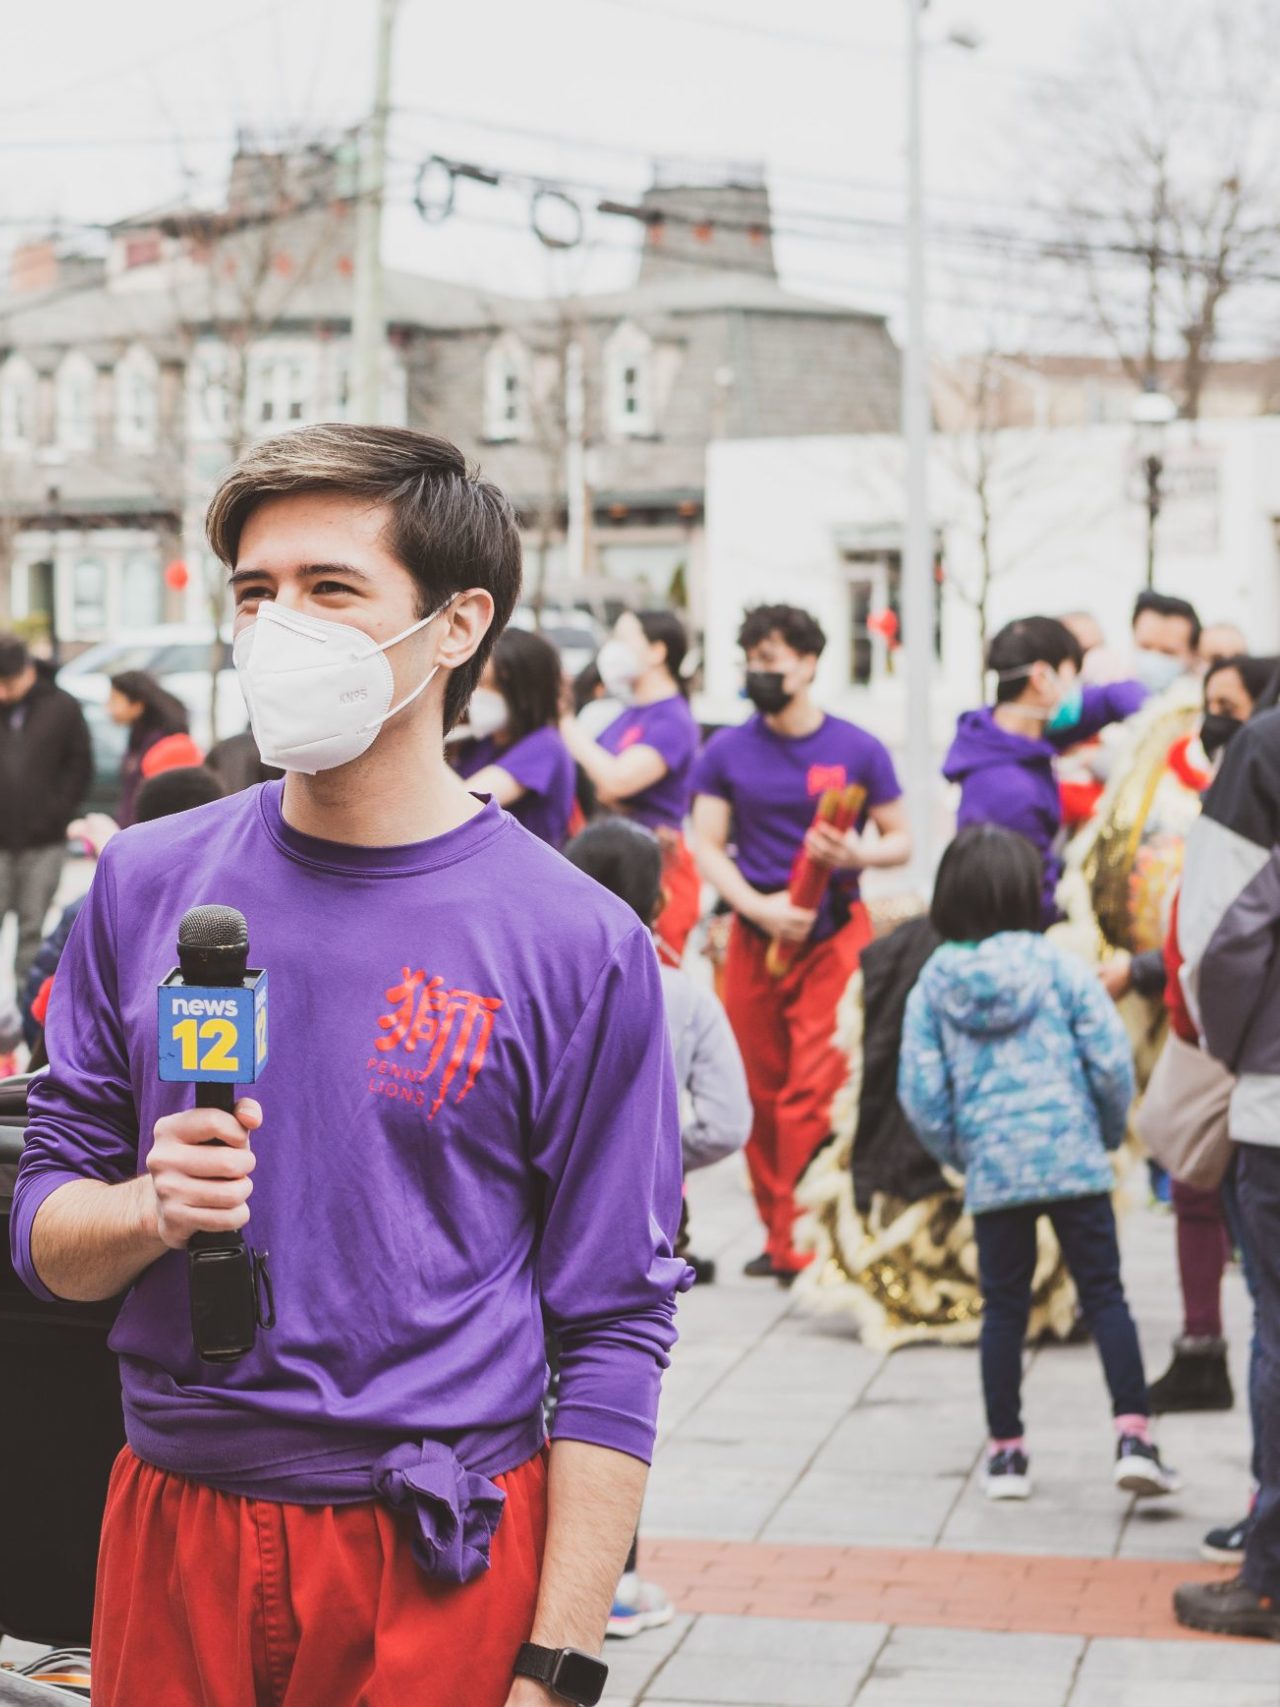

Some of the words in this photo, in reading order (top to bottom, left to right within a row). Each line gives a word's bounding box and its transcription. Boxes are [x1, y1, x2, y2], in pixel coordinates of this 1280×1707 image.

[172, 998, 239, 1016] news
[172, 1018, 239, 1071] 12
[368, 1078, 425, 1106] LIONS
